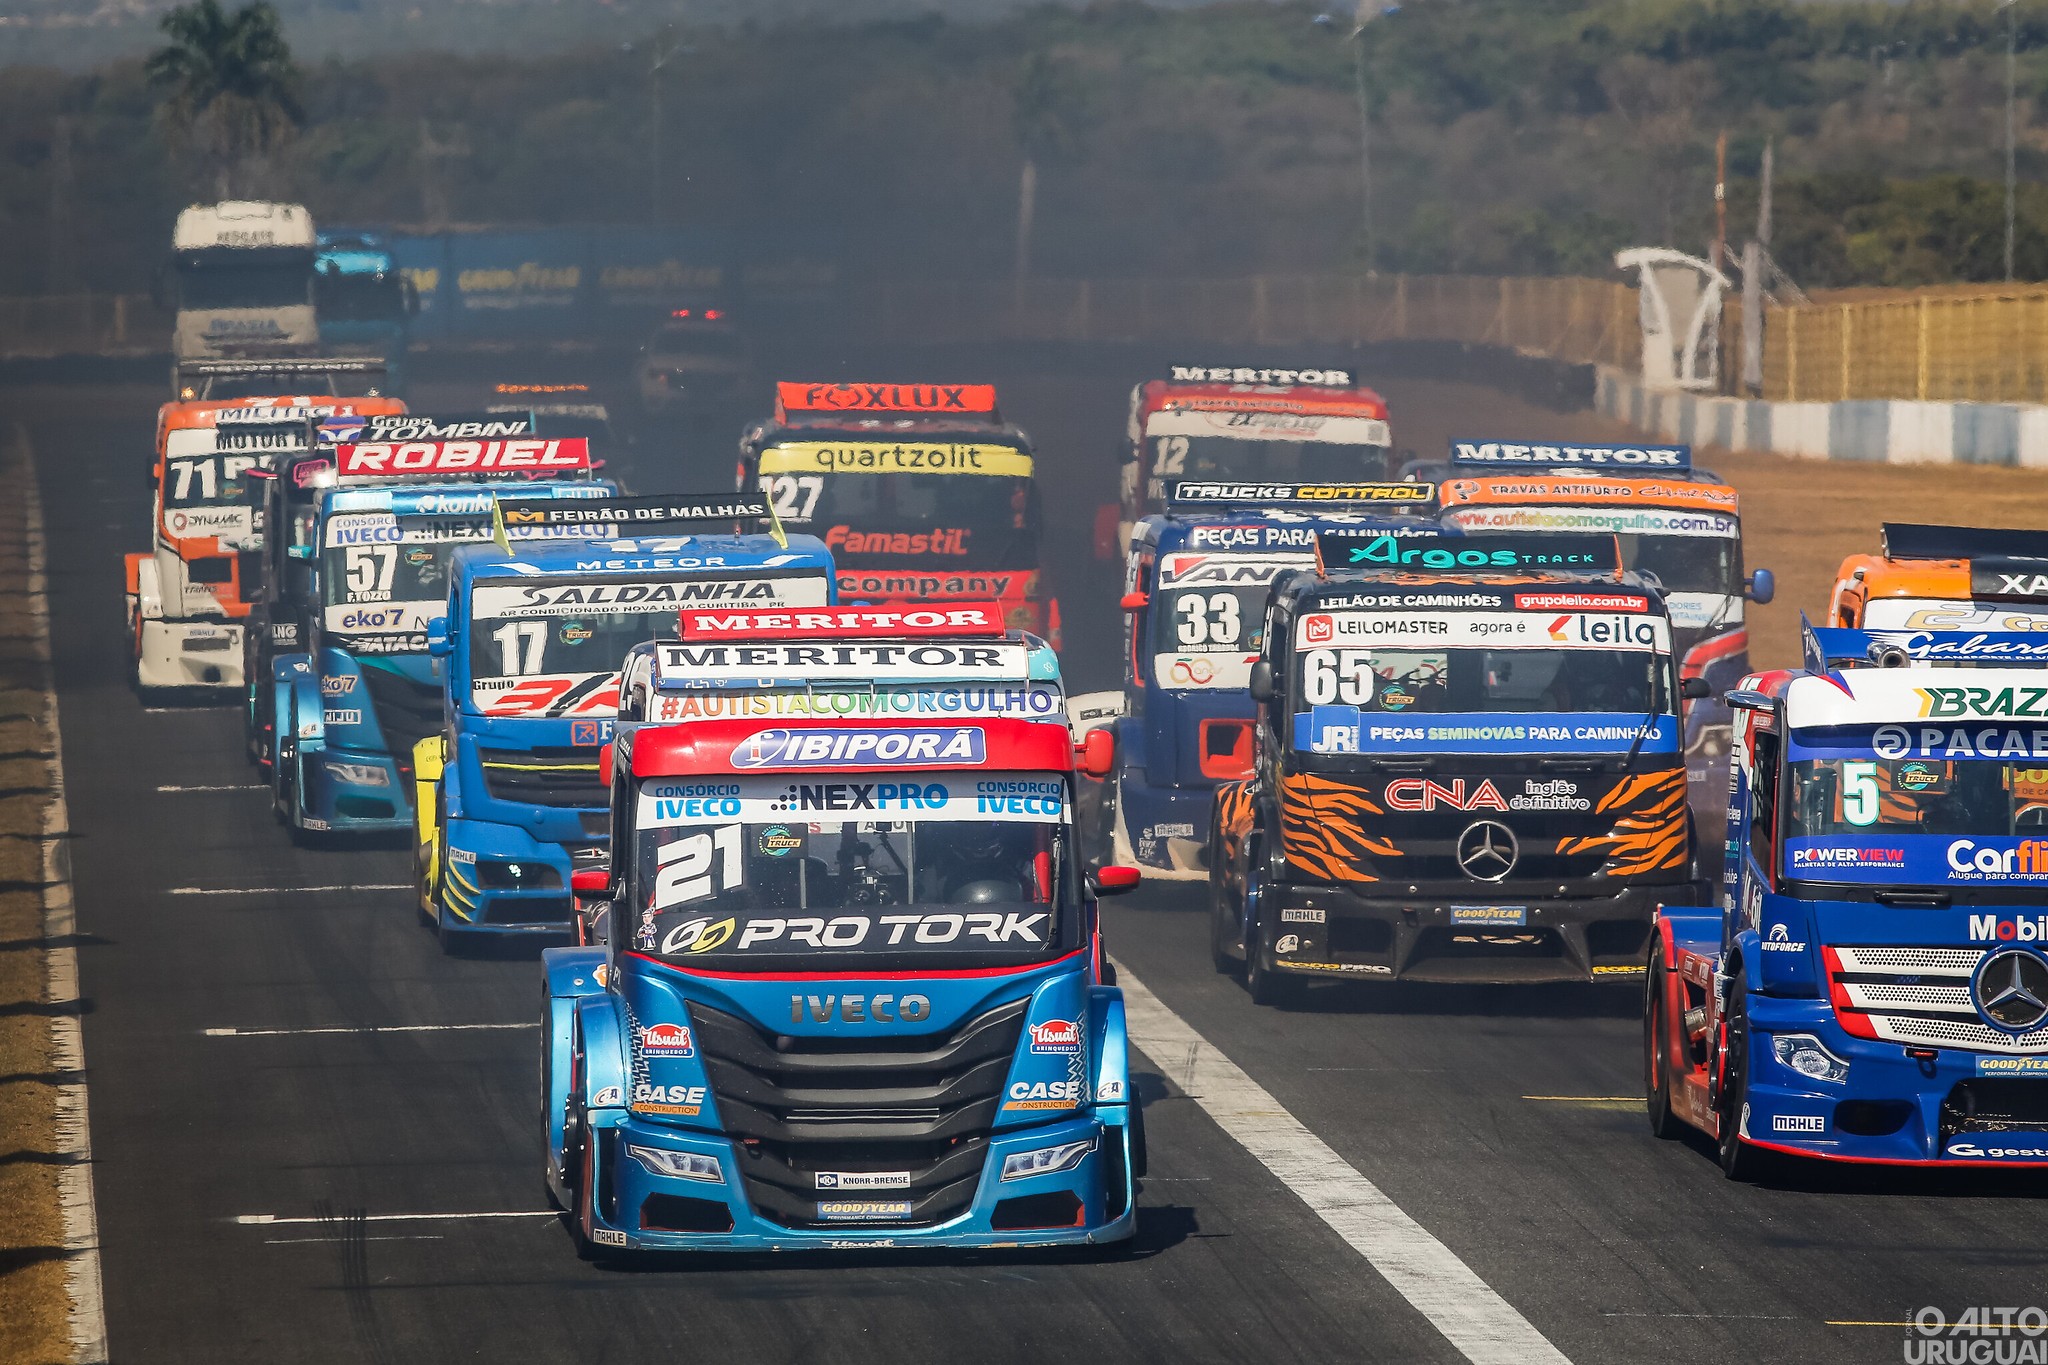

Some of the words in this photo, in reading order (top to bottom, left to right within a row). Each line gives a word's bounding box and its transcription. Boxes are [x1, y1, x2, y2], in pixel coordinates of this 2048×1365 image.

[1171, 365, 1350, 385] MERITOR
[371, 416, 432, 427] Grupo
[371, 421, 527, 441] TOMBINI
[347, 440, 580, 471] ROBIEL
[816, 445, 982, 470] quartzolit
[1153, 436, 1189, 475] 12
[1456, 443, 1681, 465] MERITOR
[171, 457, 216, 500] 71
[1182, 486, 1291, 499] TRUCKS
[1296, 486, 1427, 500] CONTROL
[1490, 485, 1546, 495] TRAVAS
[1551, 485, 1632, 496] ANTIFURTO
[551, 507, 625, 522] FEIRÃO
[629, 507, 662, 520] DE
[665, 503, 764, 518] MALHAS
[336, 525, 405, 544] IVECO
[1193, 528, 1259, 549] PEÇAS
[1265, 527, 1316, 546] PARA
[1350, 536, 1518, 568] Argos
[1521, 554, 1594, 563] TRACK
[346, 545, 397, 592] 57
[577, 557, 726, 571] METEOR
[505, 583, 776, 608] SALDANHA
[837, 576, 1011, 599] company
[520, 606, 619, 616] CONDICIONADO
[624, 604, 658, 612] NOVA
[698, 601, 758, 610] CURITIBA
[1320, 593, 1376, 610] LEILÃO
[1378, 596, 1402, 608] DE
[1403, 592, 1502, 608] CAMINHÕES
[1520, 595, 1644, 610] grupoleilo.com.br
[694, 610, 989, 631] MERITOR
[1177, 593, 1241, 645] 33
[1338, 620, 1449, 635] LEILOMASTER
[1469, 621, 1514, 638] agora
[1516, 619, 1527, 633] é
[1580, 615, 1655, 645] leilo
[492, 620, 548, 677] 17
[666, 646, 1005, 668] MERITOR
[473, 679, 515, 691] Grupo
[1304, 649, 1375, 706] 65
[660, 688, 1054, 720] #AUTISTACOMORGULHO
[1924, 688, 2048, 717] BRAZ
[1370, 726, 1425, 742] PEÇAS
[1427, 725, 1526, 741] SEMINOVAS
[1529, 726, 1572, 741] PARA
[1574, 723, 1662, 741] CAMINHÃO
[783, 729, 974, 761] IBIPORÃ
[1384, 778, 1510, 812] CNA
[1525, 778, 1577, 795] inglês
[1843, 762, 1880, 826] 5
[801, 783, 949, 811] NEXPRO
[977, 795, 1062, 816] IVECO
[1509, 795, 1591, 810] definitivo
[655, 798, 742, 820] IVECO
[770, 840, 800, 848] TRUCK
[1794, 848, 1904, 862] POWERVIEW
[655, 823, 744, 912] 21
[1948, 871, 1983, 880] Alugue
[1985, 872, 2007, 881] para
[1284, 910, 1323, 921] MAHLE
[1454, 908, 1523, 919] GOODYEAR
[737, 917, 870, 950] PRO
[879, 913, 1048, 945] TORK
[791, 994, 931, 1023] IVECO
[642, 1027, 689, 1046] Usual
[1031, 1023, 1077, 1043] Usual
[635, 1085, 706, 1104] CASE
[1009, 1082, 1080, 1099] CASE
[639, 1104, 698, 1114] CONSTRUCTION
[1016, 1101, 1075, 1109] CONSTRUCTION
[1775, 1118, 1824, 1131] MAHLE
[843, 1176, 909, 1185] KNORR-BREMSE
[822, 1203, 906, 1214] GOODYEAR
[595, 1230, 624, 1243] MAHLE
